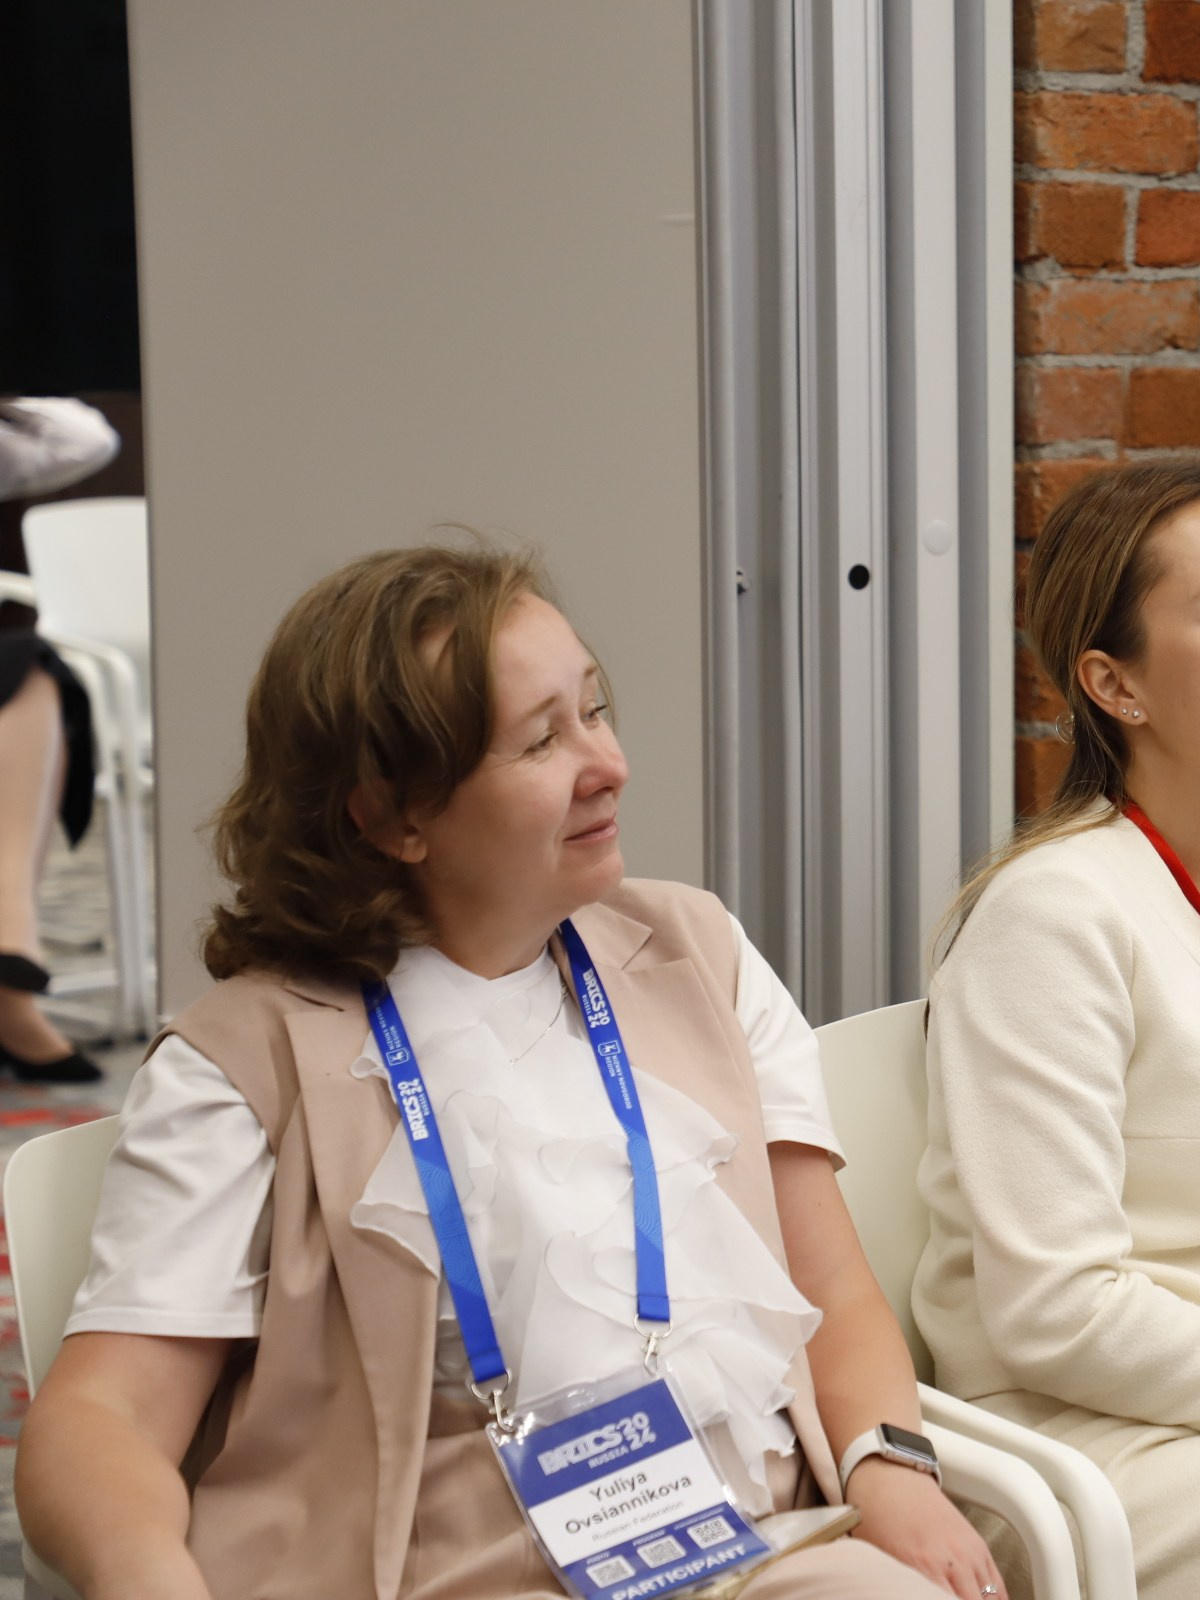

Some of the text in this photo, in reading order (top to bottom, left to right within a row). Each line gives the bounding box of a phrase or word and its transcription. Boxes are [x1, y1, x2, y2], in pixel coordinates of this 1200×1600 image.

[582, 994, 601, 1028] RUSSIA 24
[583, 968, 610, 1025] BRICS 20
[383, 1029, 396, 1050] NIZHNY
[390, 1025, 402, 1049] REGION
[409, 1079, 423, 1094] 24
[605, 1055, 616, 1077] REGION
[612, 1054, 632, 1110] NIZHNY NOVGOROD
[397, 1081, 429, 1141] BRICS 20
[537, 1411, 649, 1476] BRICS 20
[588, 1427, 657, 1469] RUSSIA 24
[565, 1476, 692, 1534] Ovsiannikova
[589, 1472, 648, 1502] Yuliya
[592, 1521, 631, 1542] Russian
[632, 1501, 684, 1526] Federation
[611, 1542, 746, 1600] PARTICIPANT
